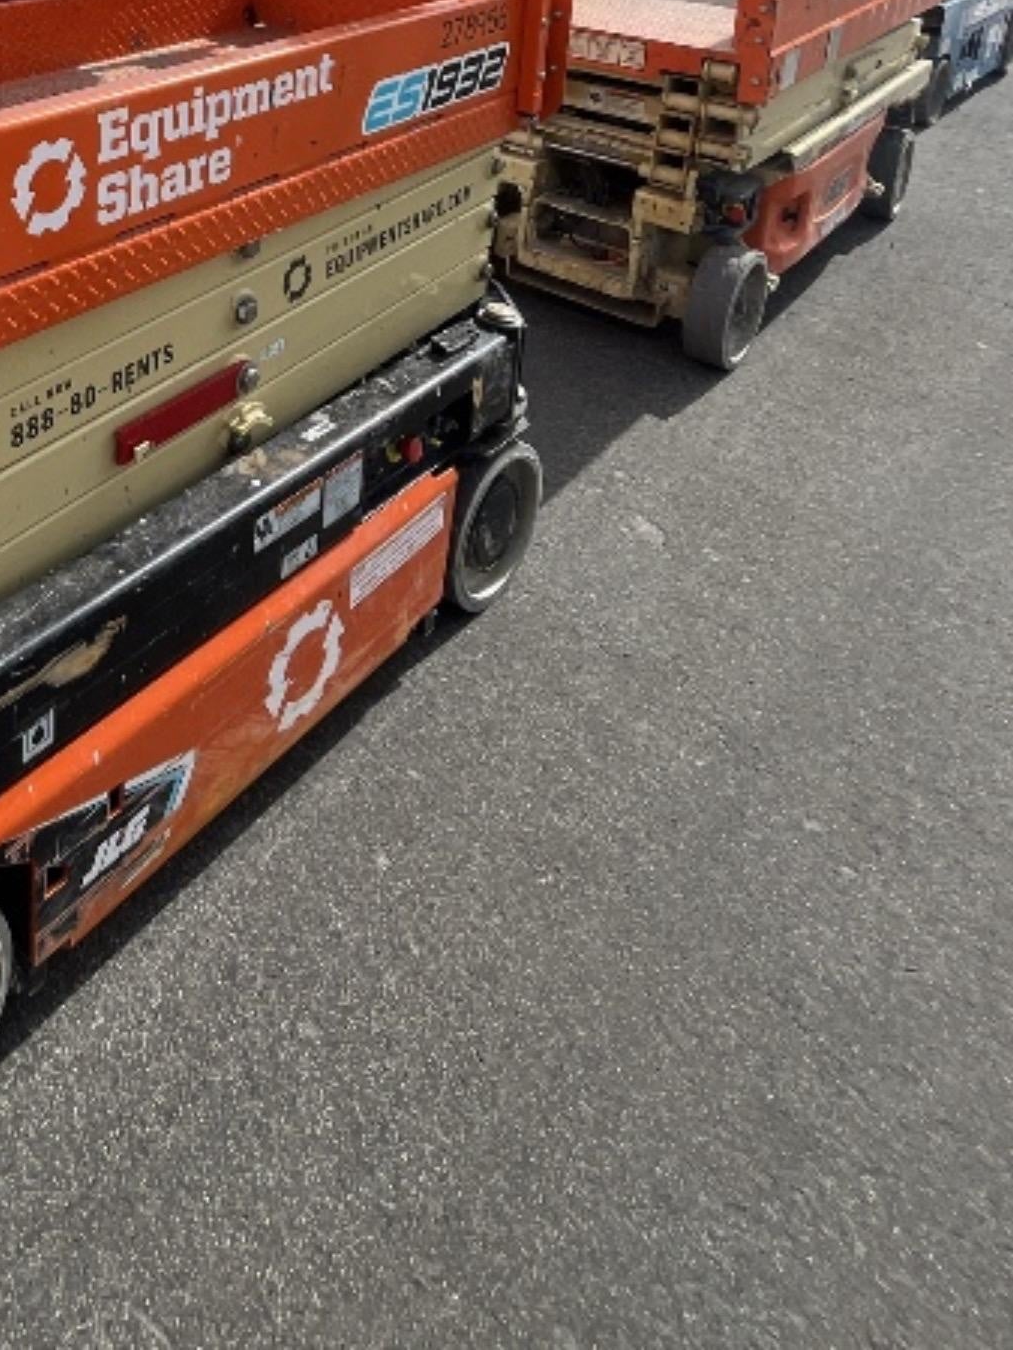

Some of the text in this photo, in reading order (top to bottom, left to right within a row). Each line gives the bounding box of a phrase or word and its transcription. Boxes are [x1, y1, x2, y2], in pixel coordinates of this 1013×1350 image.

[97, 53, 335, 164] Equipment
[363, 42, 509, 134] ES1932
[97, 147, 231, 226] Share
[80, 804, 152, 889] JLG
